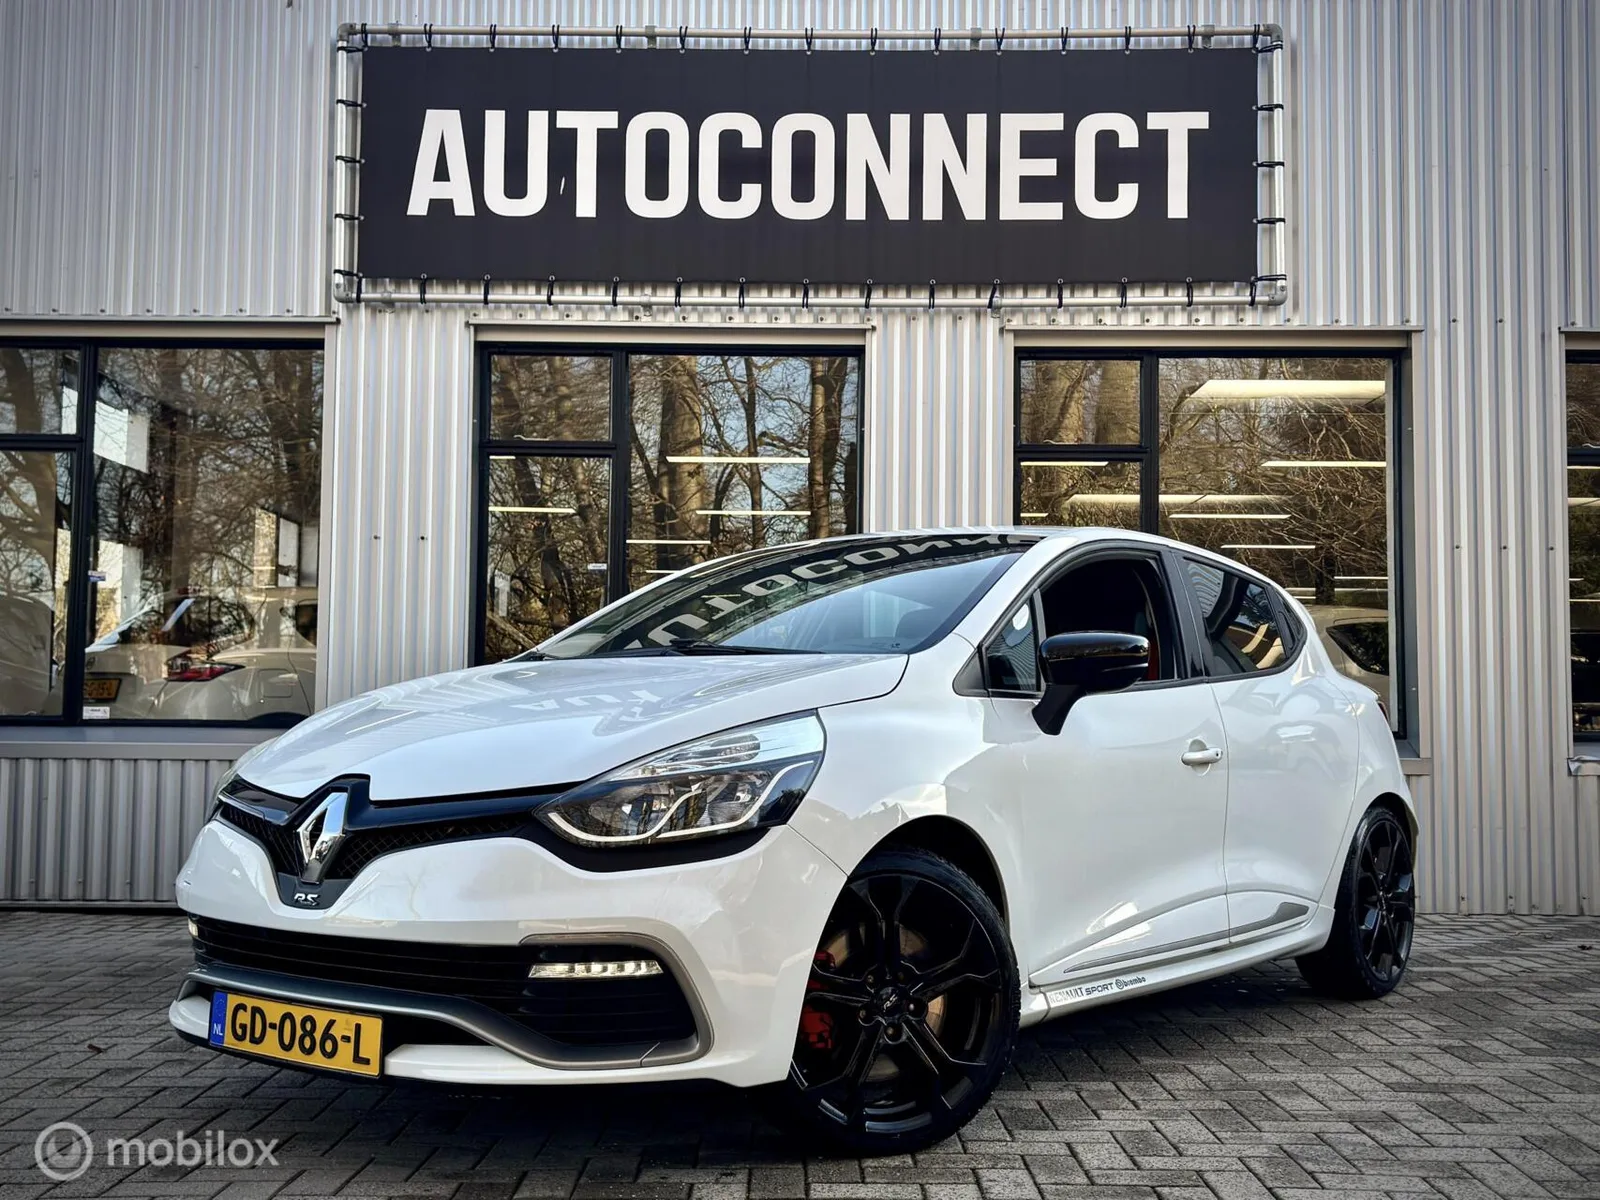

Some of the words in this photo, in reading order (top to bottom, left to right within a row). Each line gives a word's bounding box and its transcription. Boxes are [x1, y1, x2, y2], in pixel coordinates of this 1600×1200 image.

[407, 109, 1210, 221] AUTOCONNECT
[1049, 987, 1084, 1003] RENAULT
[1085, 982, 1114, 996] SPORT
[1123, 976, 1147, 987] brembo
[213, 1023, 223, 1036] NL
[231, 1003, 371, 1066] GD-086-L
